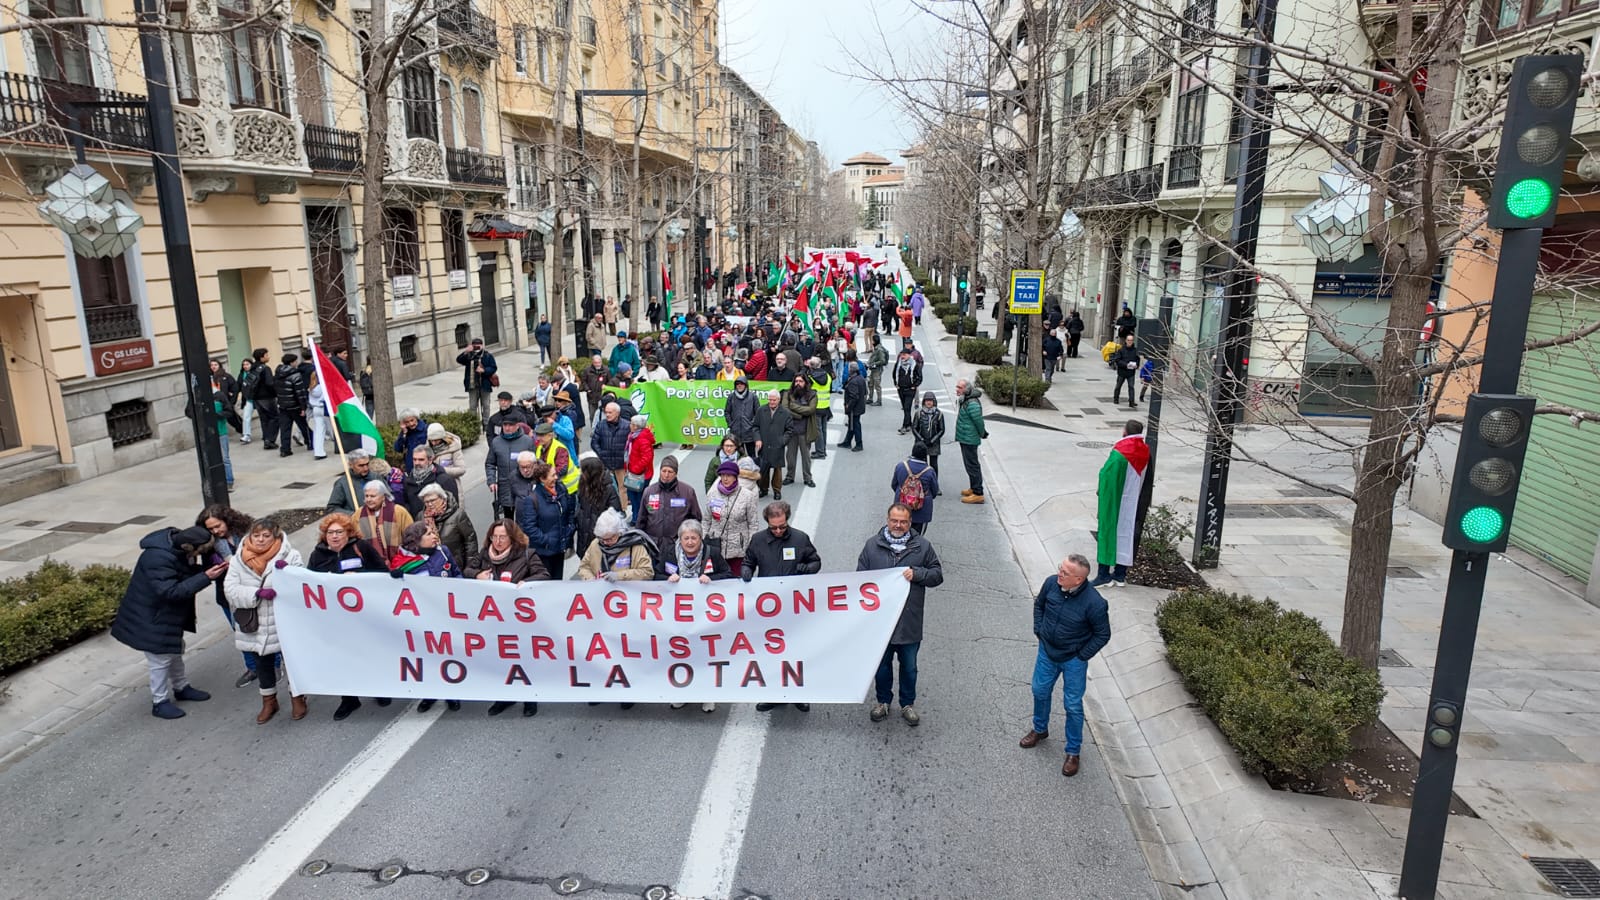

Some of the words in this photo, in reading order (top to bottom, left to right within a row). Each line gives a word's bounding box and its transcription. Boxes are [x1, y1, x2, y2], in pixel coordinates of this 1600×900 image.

[114, 350, 125, 358] GS
[125, 346, 148, 356] LEGAL
[666, 387, 692, 399] Por
[695, 386, 709, 399] el
[694, 408, 704, 421] y
[682, 423, 695, 436] el
[302, 583, 364, 613] NO
[392, 588, 420, 616] A
[448, 592, 537, 623] LAS
[566, 582, 881, 623] AGRESIONES
[405, 628, 786, 661] IMPERIALISTAS
[400, 657, 467, 684] NO
[505, 664, 532, 686] A
[569, 664, 631, 688] LA
[668, 660, 804, 688] OTAN
